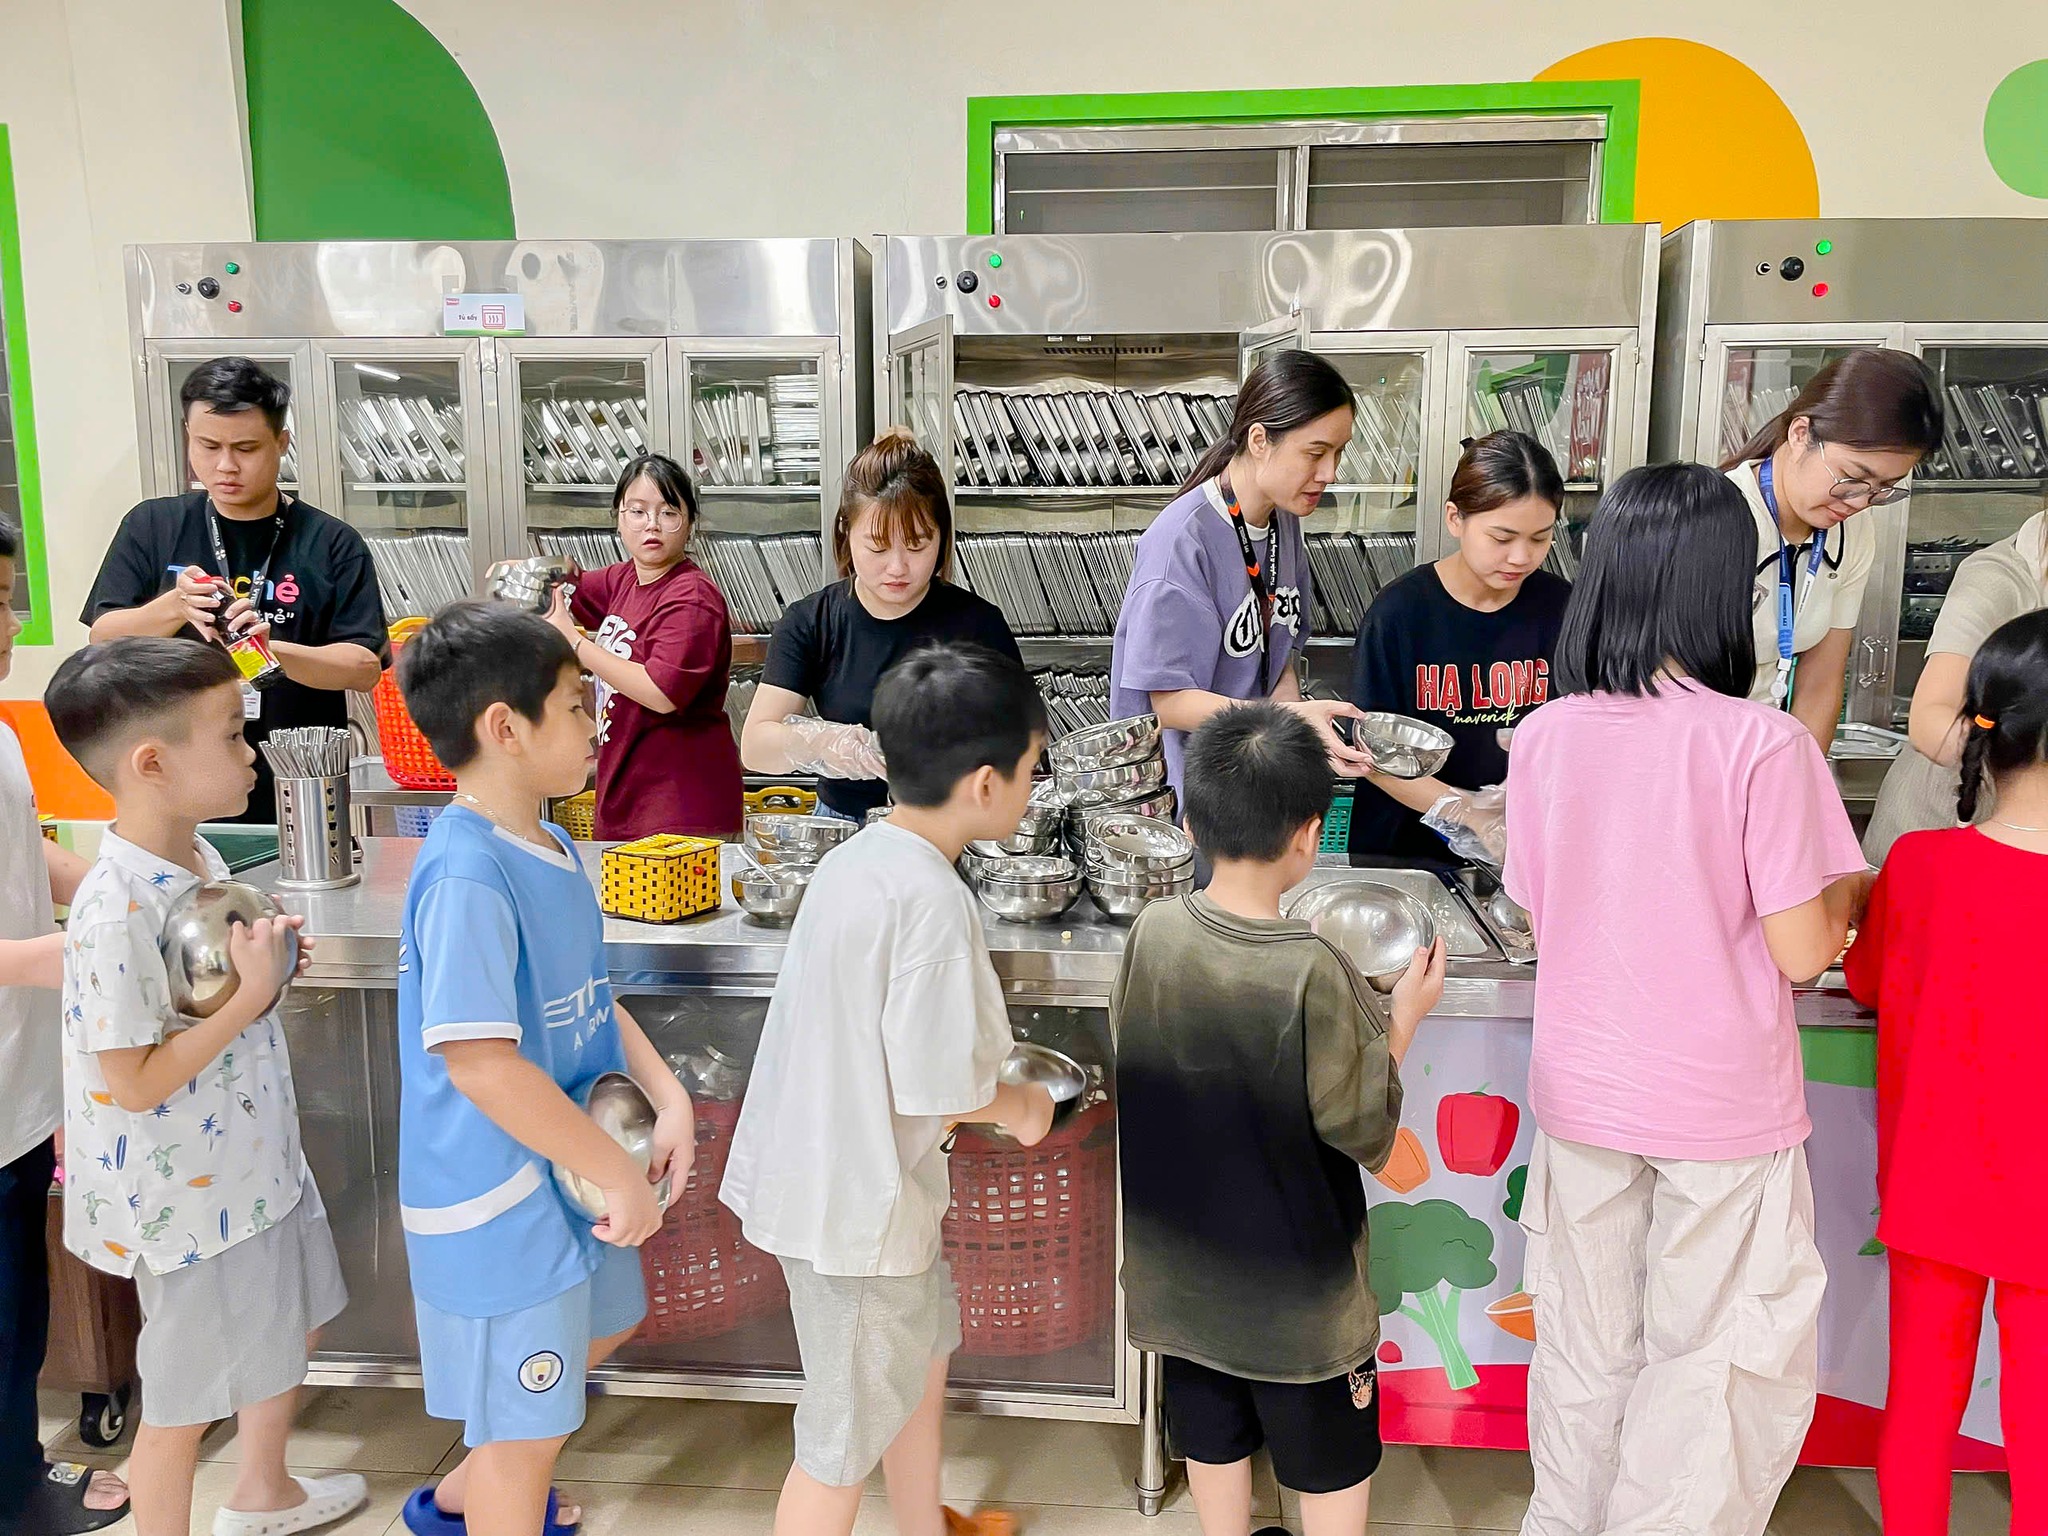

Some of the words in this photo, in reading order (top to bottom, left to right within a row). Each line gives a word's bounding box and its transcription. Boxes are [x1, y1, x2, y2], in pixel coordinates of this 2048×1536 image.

[1416, 664, 1463, 717] HẠ
[1472, 658, 1549, 709] LONG
[1453, 700, 1520, 727] maverick
